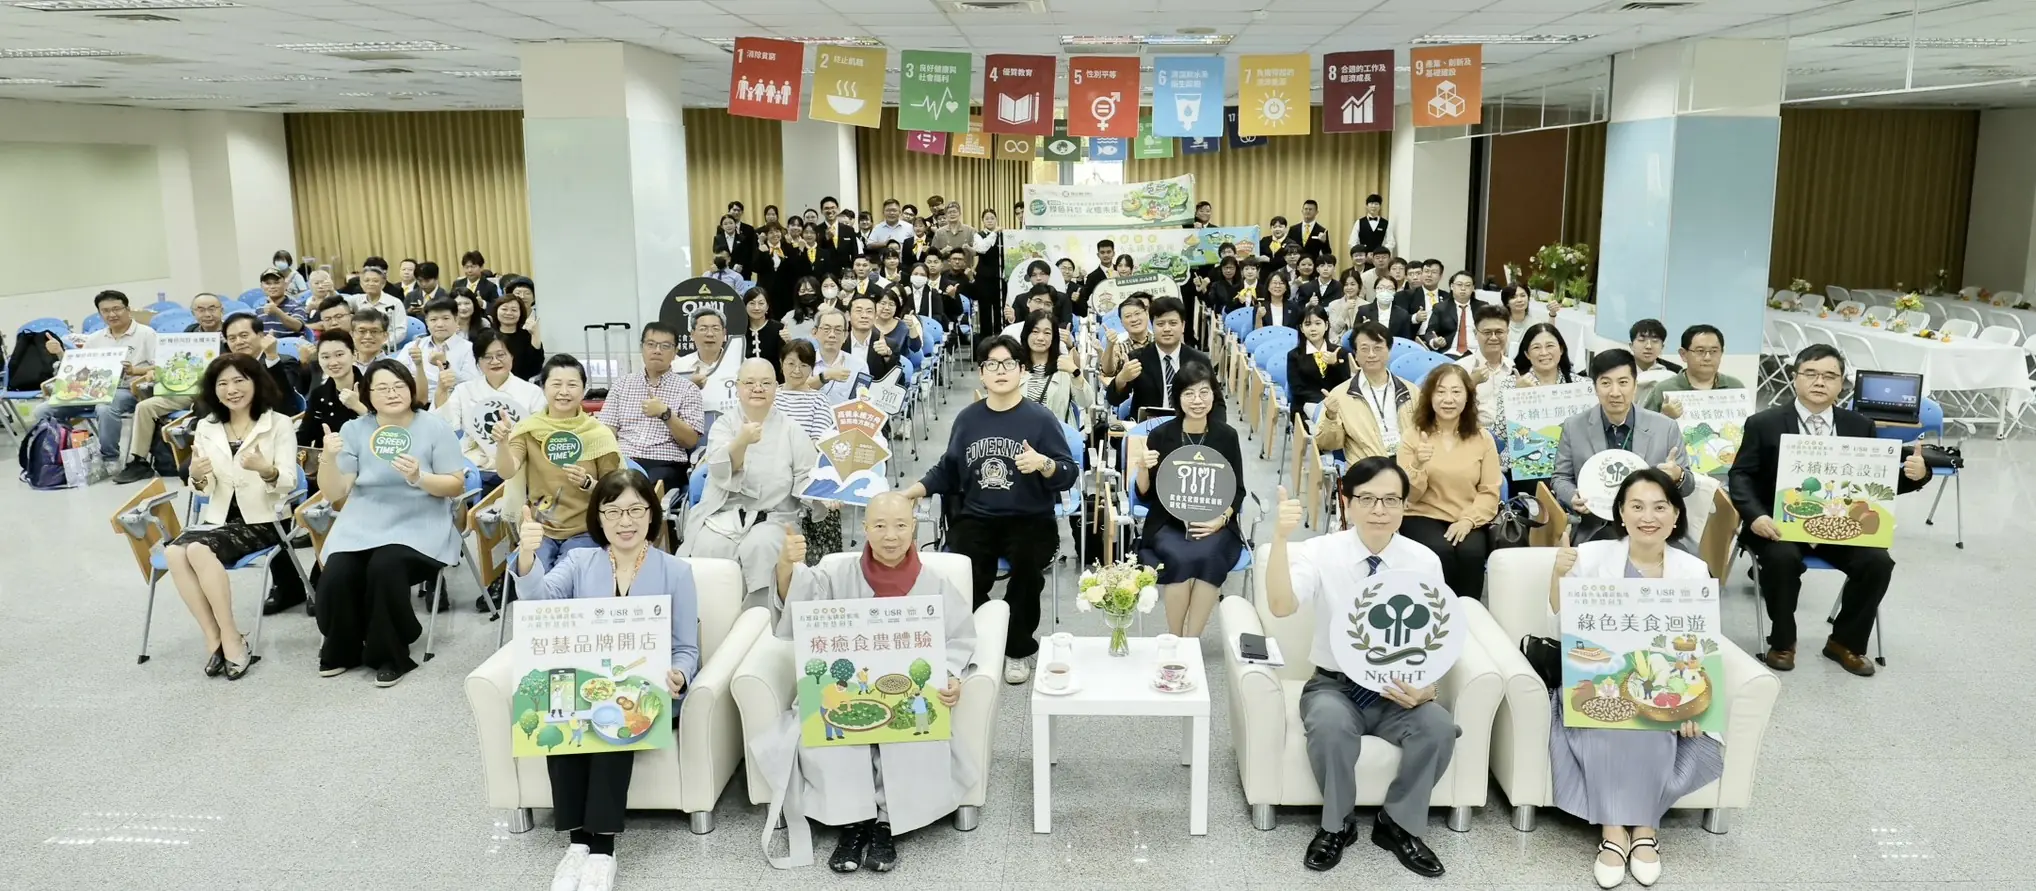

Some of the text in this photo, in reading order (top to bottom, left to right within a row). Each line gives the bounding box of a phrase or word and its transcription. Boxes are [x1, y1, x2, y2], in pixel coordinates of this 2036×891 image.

[737, 48, 744, 63] 1
[746, 50, 776, 61] 消除貧窮
[820, 53, 829, 68] 2
[905, 63, 914, 78] 3
[1002, 67, 1032, 77] 優質教育
[1328, 65, 1337, 81] 8
[1341, 64, 1387, 74] 合適的工作及
[1415, 60, 1424, 76] 9
[989, 67, 998, 82] 4
[1074, 69, 1083, 84] 5
[1086, 70, 1117, 79] 性別平等
[1158, 70, 1167, 86] 6
[1244, 69, 1252, 85] 7
[1340, 74, 1372, 83] 經濟成長
[1228, 113, 1236, 123] 17
[376, 437, 406, 446] GREEN
[375, 446, 395, 454] TIME
[547, 443, 577, 452] GREEN
[548, 452, 567, 460] TIME
[1656, 589, 1675, 597] USR
[610, 608, 629, 617] USR
[884, 608, 902, 617] USR
[530, 631, 658, 656] 智慧品牌開店
[809, 630, 933, 654] 療癒食農體驗
[1364, 670, 1426, 684] NKUHT
